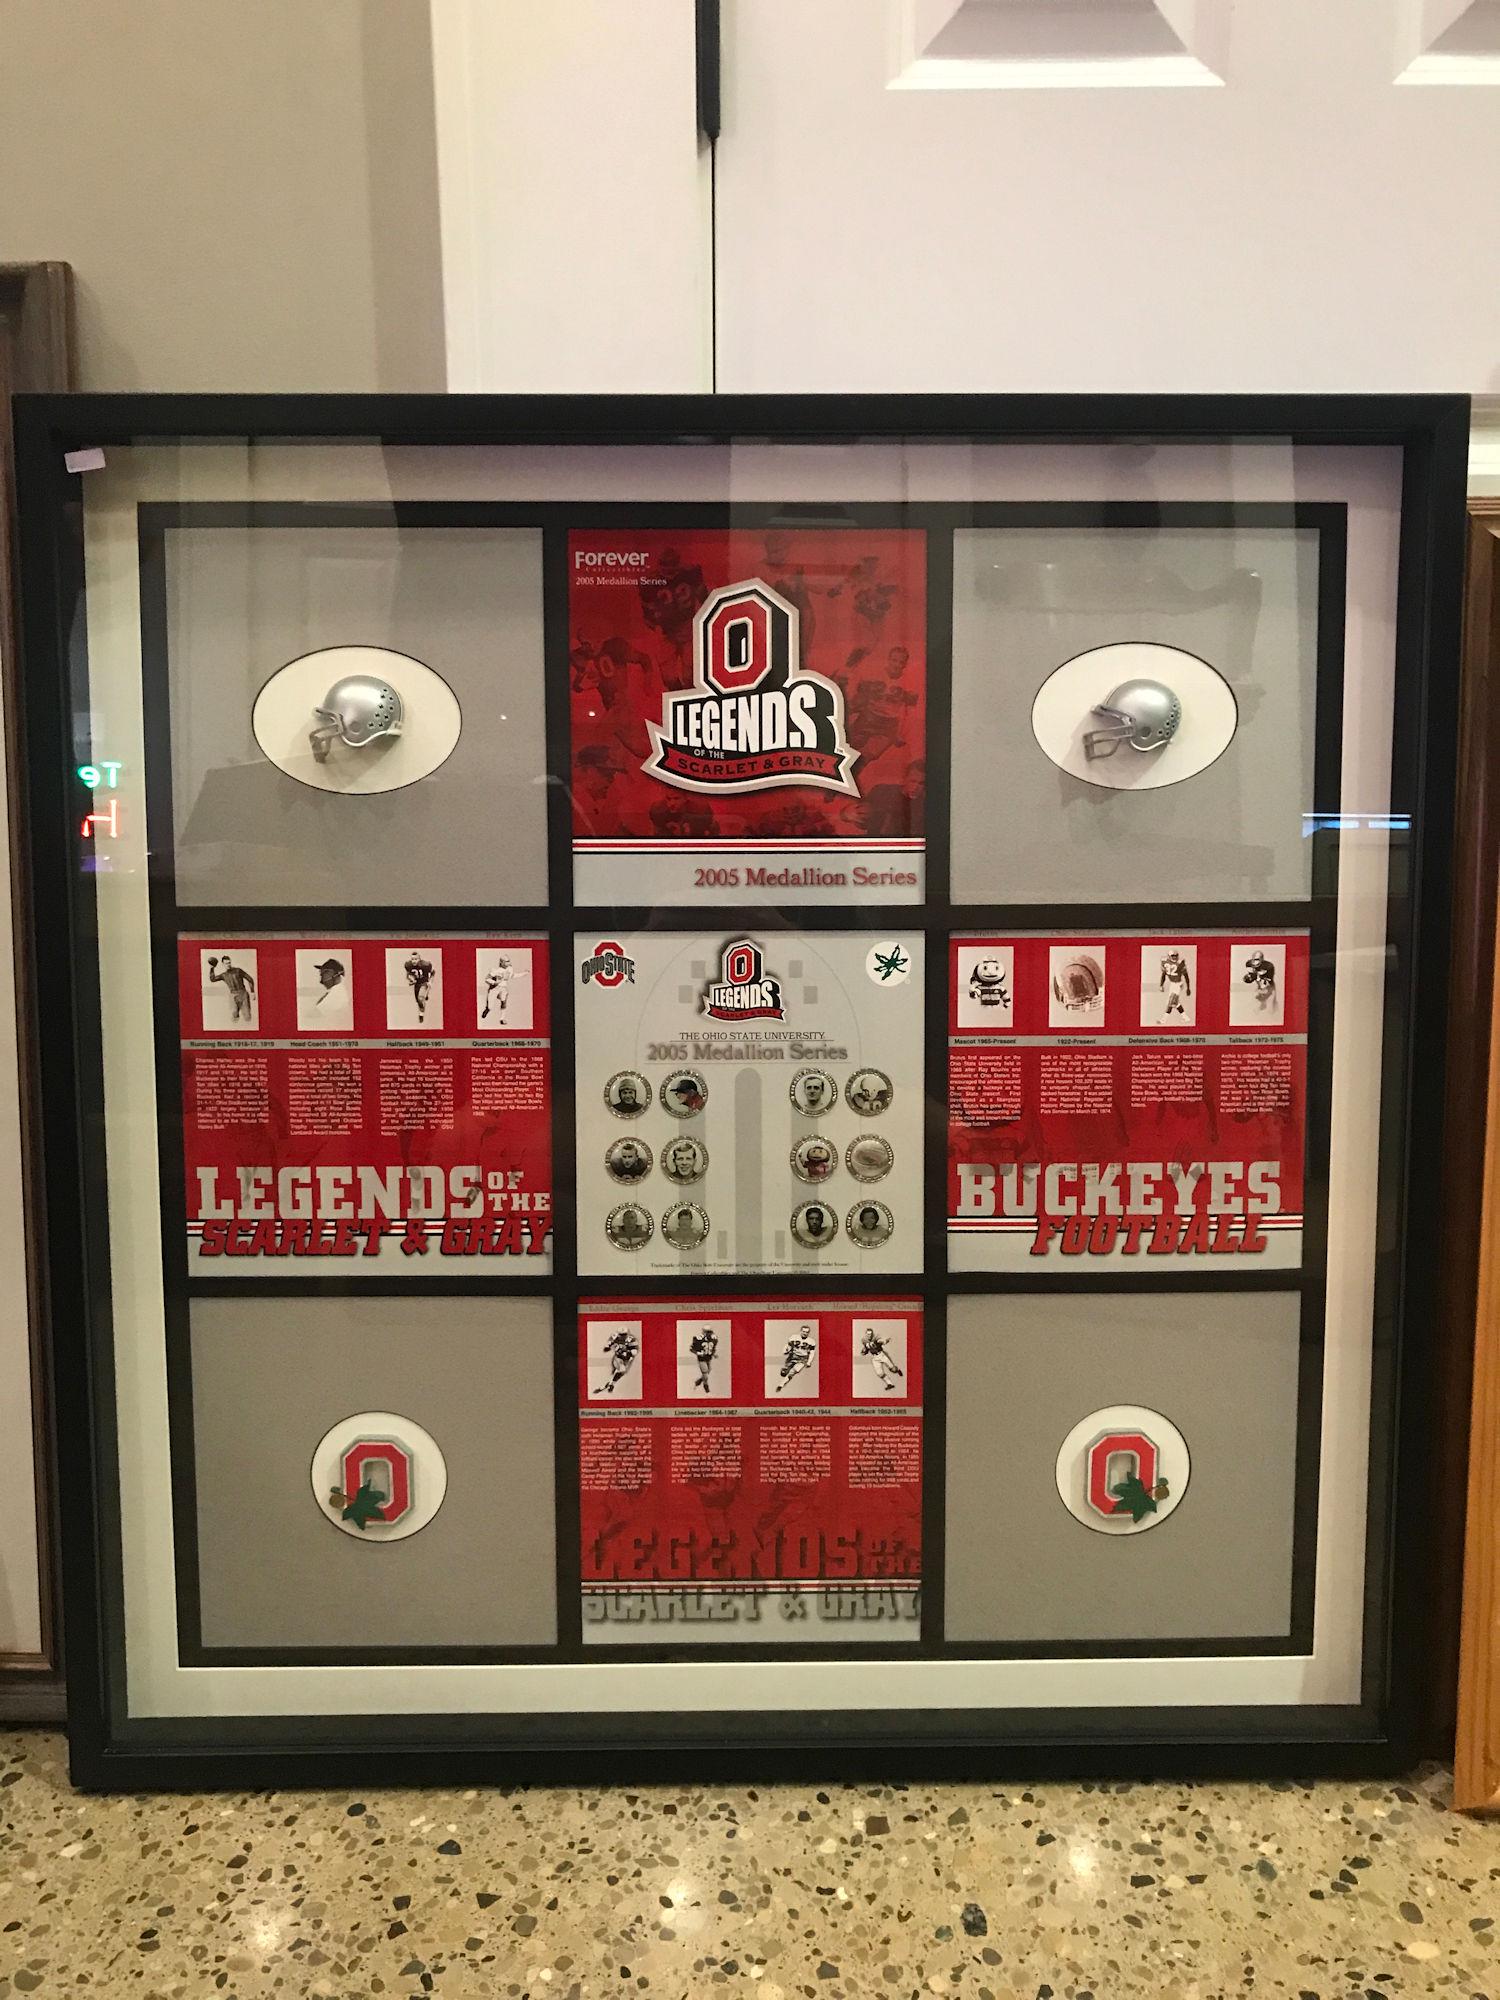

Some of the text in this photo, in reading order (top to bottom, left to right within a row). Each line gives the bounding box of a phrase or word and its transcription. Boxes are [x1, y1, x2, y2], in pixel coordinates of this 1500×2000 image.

[575, 551, 649, 569] Forever
[575, 576, 667, 586] 2005 Medallion Series
[676, 684, 818, 753] LEGENDS
[693, 749, 725, 760] OF THE
[677, 755, 826, 776] SCARLET & GRAY
[694, 866, 917, 887] 2005 Medallion Series
[714, 980, 774, 1009] LEGENDS
[679, 1032, 826, 1040] THE OHIO STATE UNIVERSITY
[648, 1042, 849, 1061] 2005 Medallion Series
[487, 1170, 525, 1191] OF
[956, 1162, 1281, 1216] BUCKEYES
[196, 1166, 484, 1219] LEGENDS
[491, 1193, 551, 1212] THE
[199, 1216, 553, 1257] SCARLET & GRAY
[1030, 1212, 1270, 1256] FOOTBALL
[583, 1584, 764, 1623] SCARLET
[817, 1584, 921, 1622] GRAY
